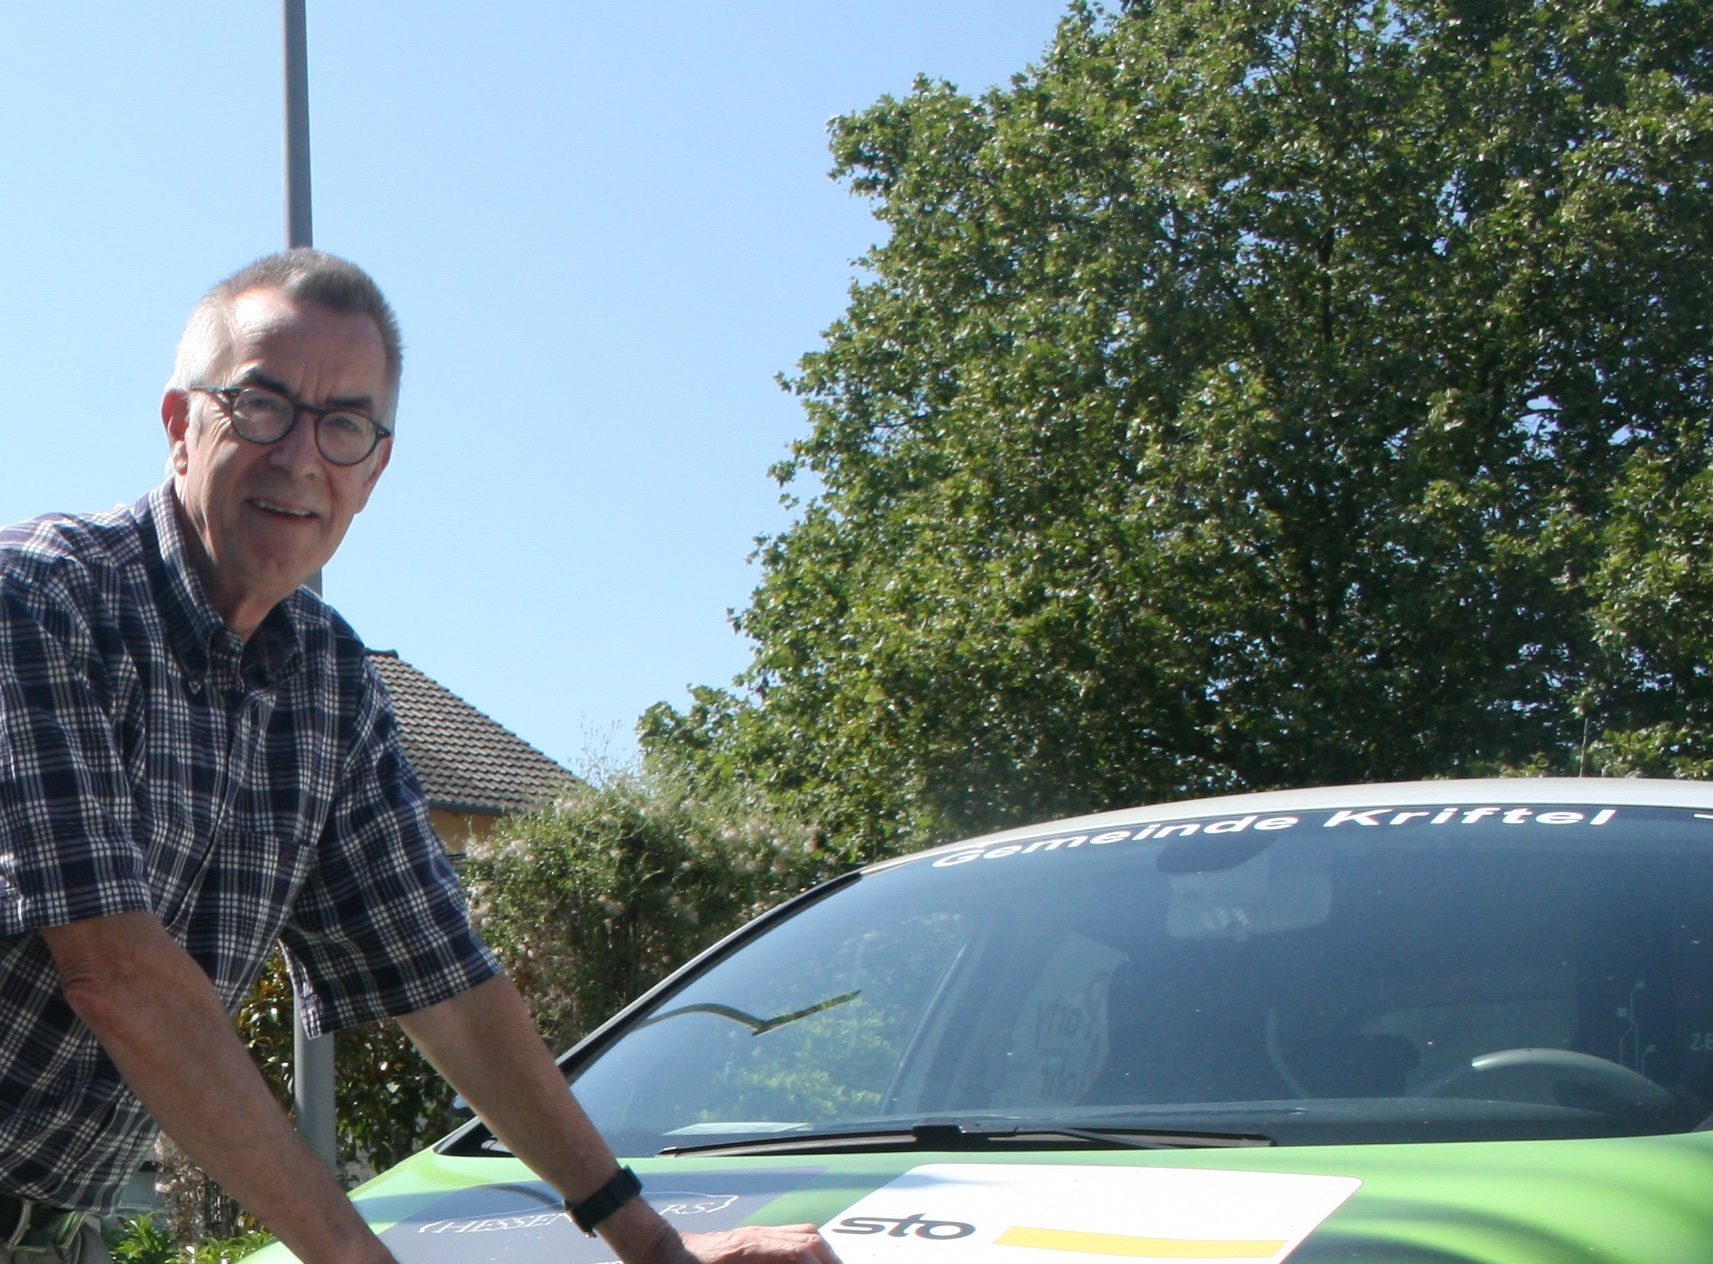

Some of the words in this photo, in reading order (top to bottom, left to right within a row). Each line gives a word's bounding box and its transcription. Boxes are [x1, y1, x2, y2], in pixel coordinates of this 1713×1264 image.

[932, 815, 1299, 868] Gemeinde
[1323, 807, 1617, 828] Kriftel
[659, 1202, 715, 1215] RS
[832, 1213, 976, 1240] sto
